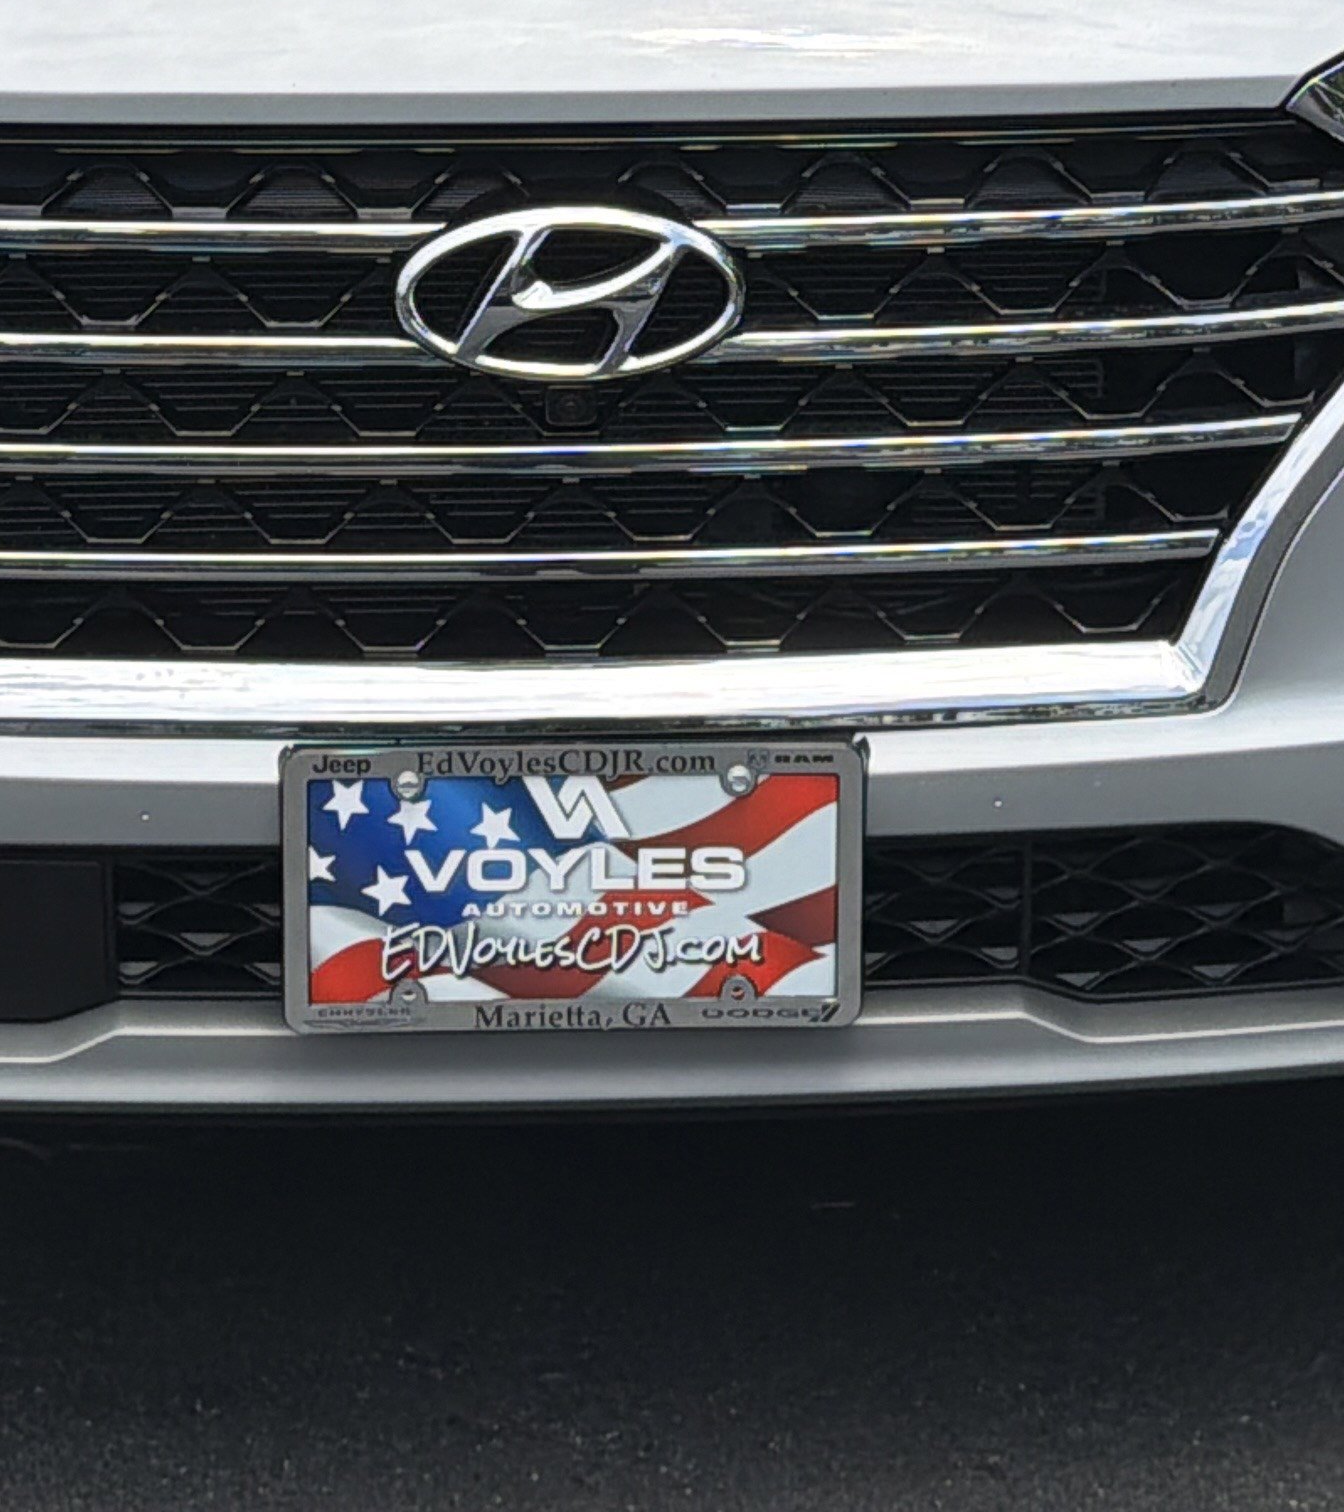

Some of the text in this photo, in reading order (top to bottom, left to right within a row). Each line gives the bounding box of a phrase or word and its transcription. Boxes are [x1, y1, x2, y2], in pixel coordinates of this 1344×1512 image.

[312, 754, 371, 775] Jeep
[417, 749, 716, 784] EdVoylesCDJR.com
[403, 846, 747, 892] VOYLES
[461, 900, 691, 918] AUTOMOTIVE
[474, 1001, 671, 1031] Marietta, GA
